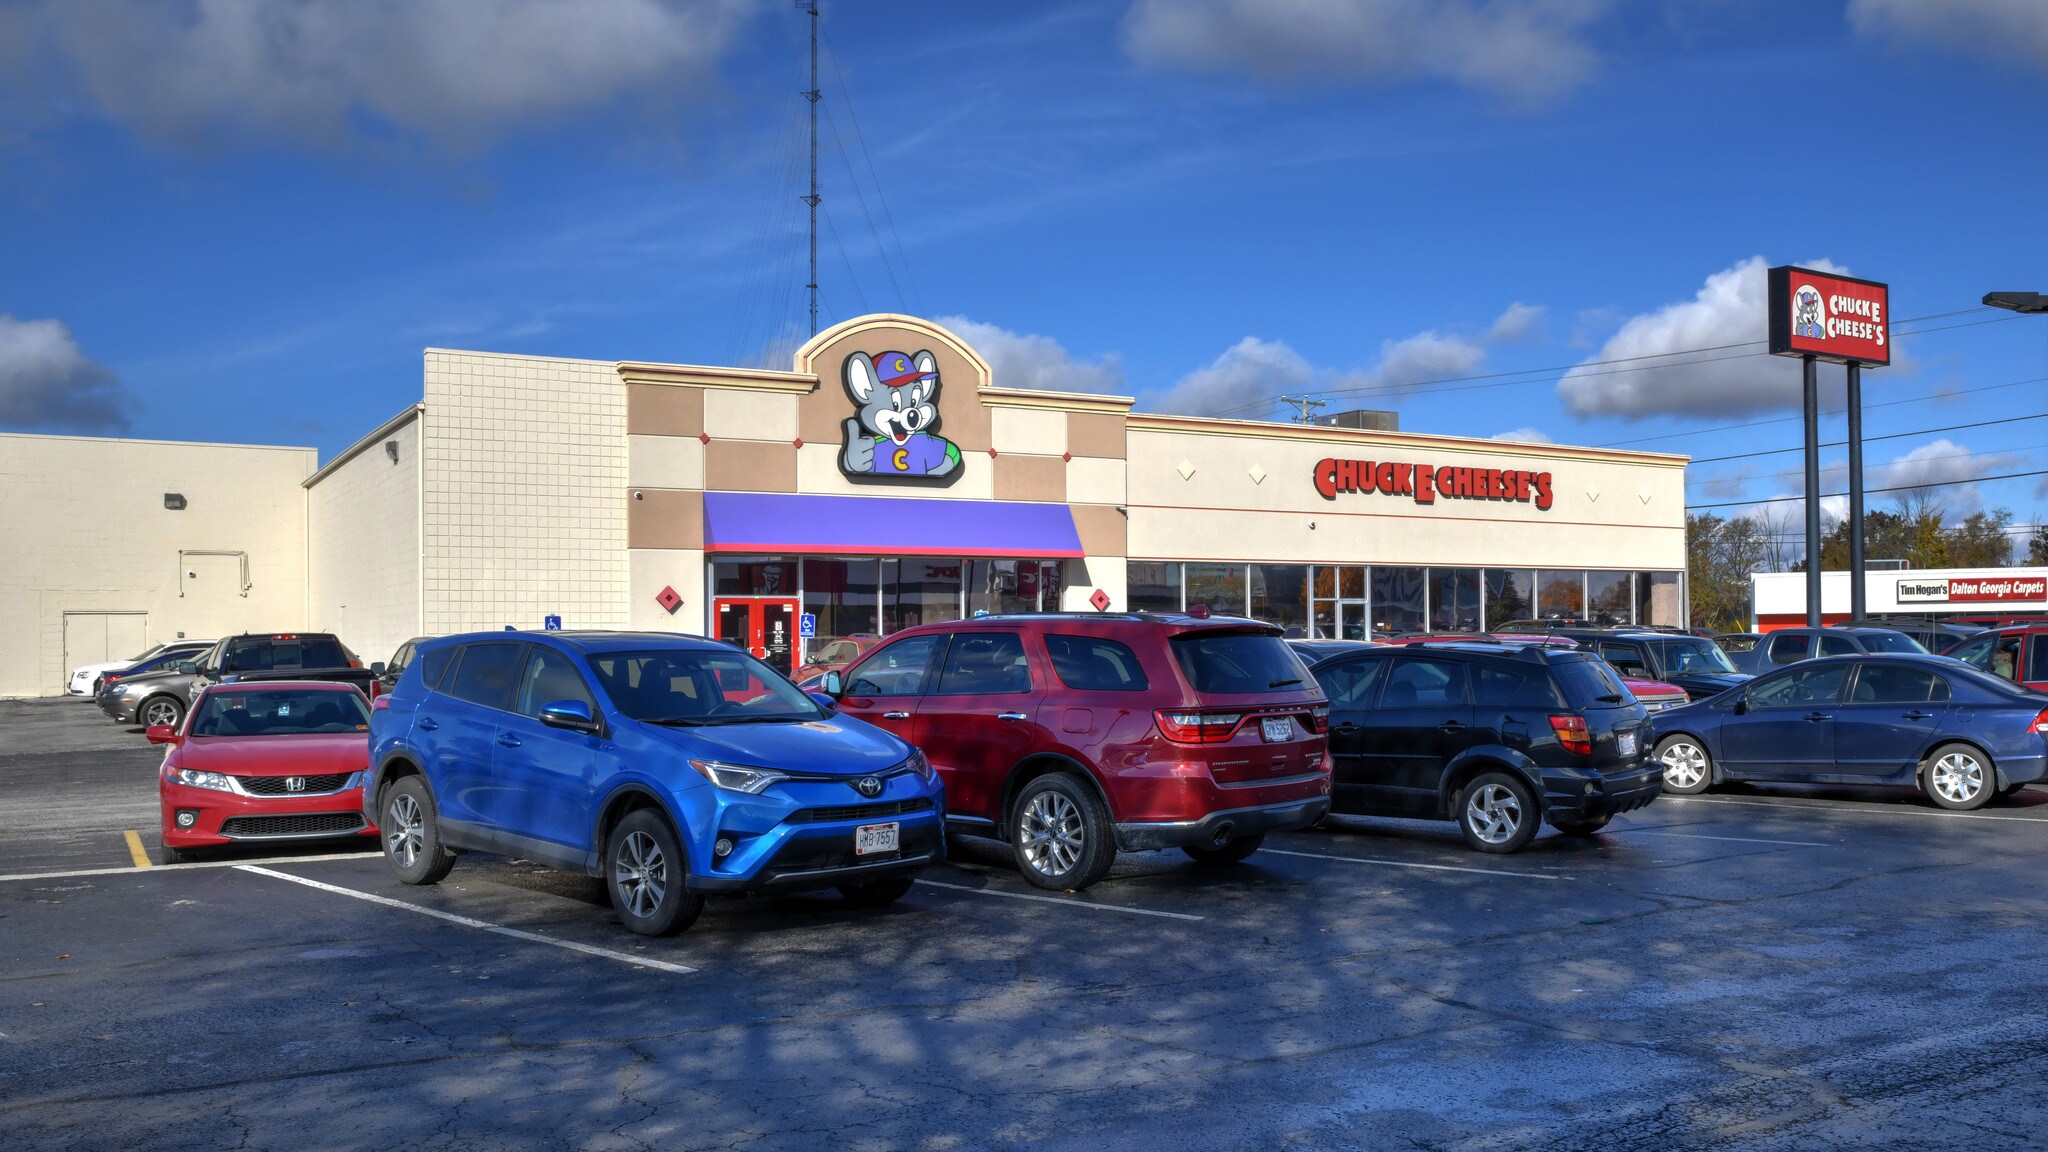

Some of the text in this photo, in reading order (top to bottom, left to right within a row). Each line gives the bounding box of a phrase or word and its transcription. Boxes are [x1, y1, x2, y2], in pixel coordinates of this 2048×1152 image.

[1830, 294, 1881, 323] CHUCK E
[1826, 317, 1885, 346] CHEESE'S
[894, 359, 906, 372] C
[892, 447, 910, 471] C
[1313, 457, 1554, 511] CHUCK E CHEESE'S
[1900, 584, 1948, 596] Tim Hogan's
[1951, 580, 2044, 597] Dalton Georgia Carpets
[876, 830, 896, 845] 7557
